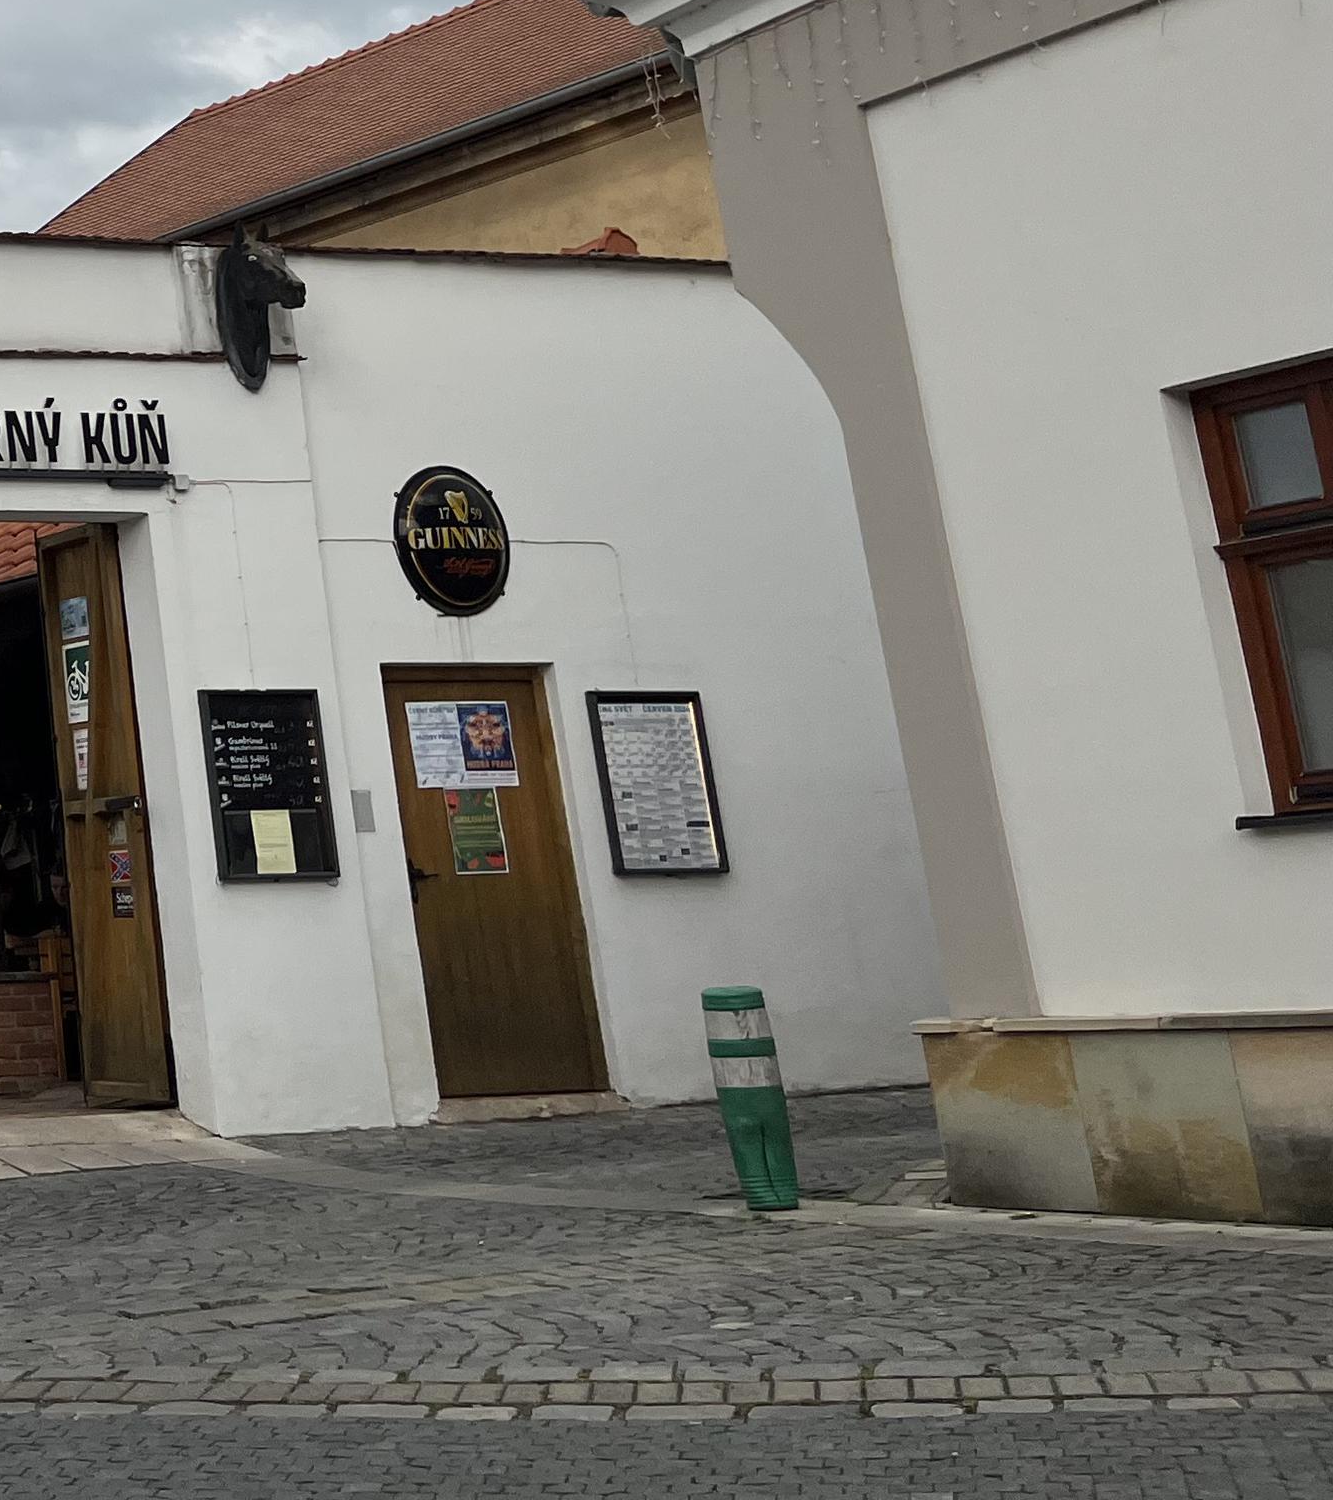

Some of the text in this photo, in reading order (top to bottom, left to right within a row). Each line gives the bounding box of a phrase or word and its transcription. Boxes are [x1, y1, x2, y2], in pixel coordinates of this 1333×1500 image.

[80, 397, 171, 465] KŮŇ
[438, 506, 483, 521] 17 59
[407, 526, 505, 550] GUINNESS
